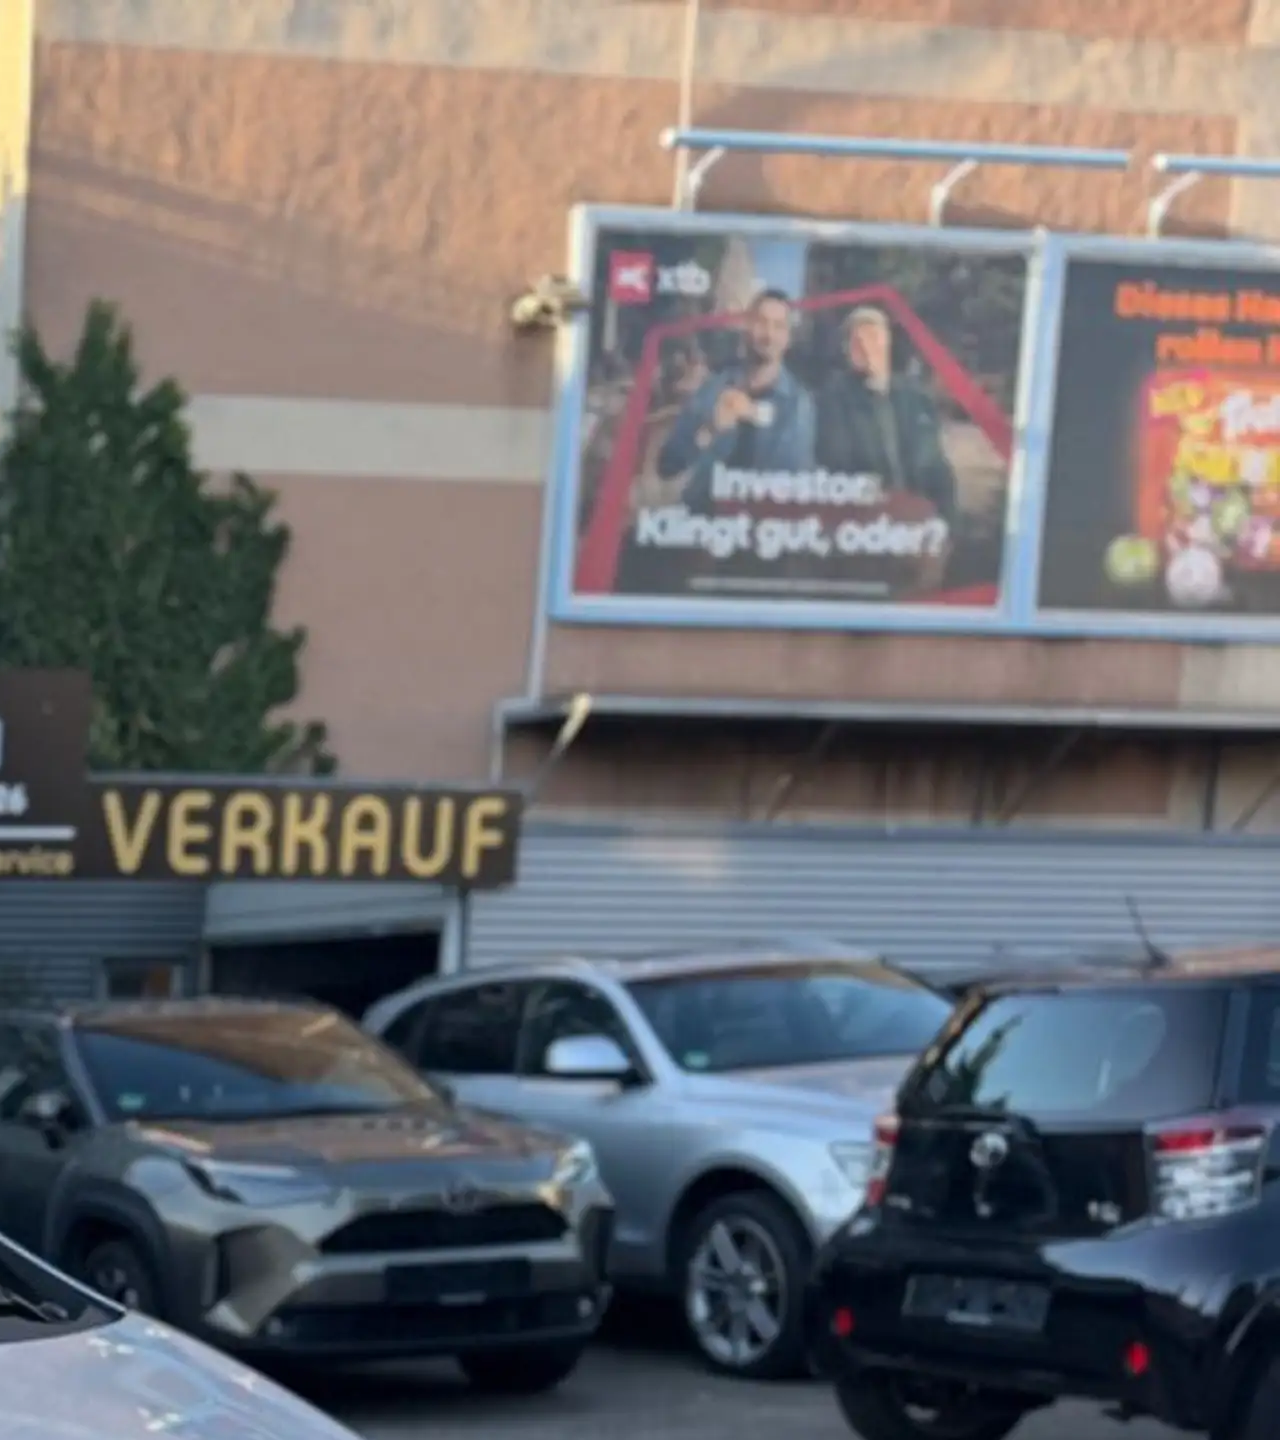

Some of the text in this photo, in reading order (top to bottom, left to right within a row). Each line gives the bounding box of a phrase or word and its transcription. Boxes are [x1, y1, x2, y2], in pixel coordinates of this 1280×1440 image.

[637, 505, 948, 560] Klingt gut, oder?
[102, 788, 512, 877] VERKAUF
